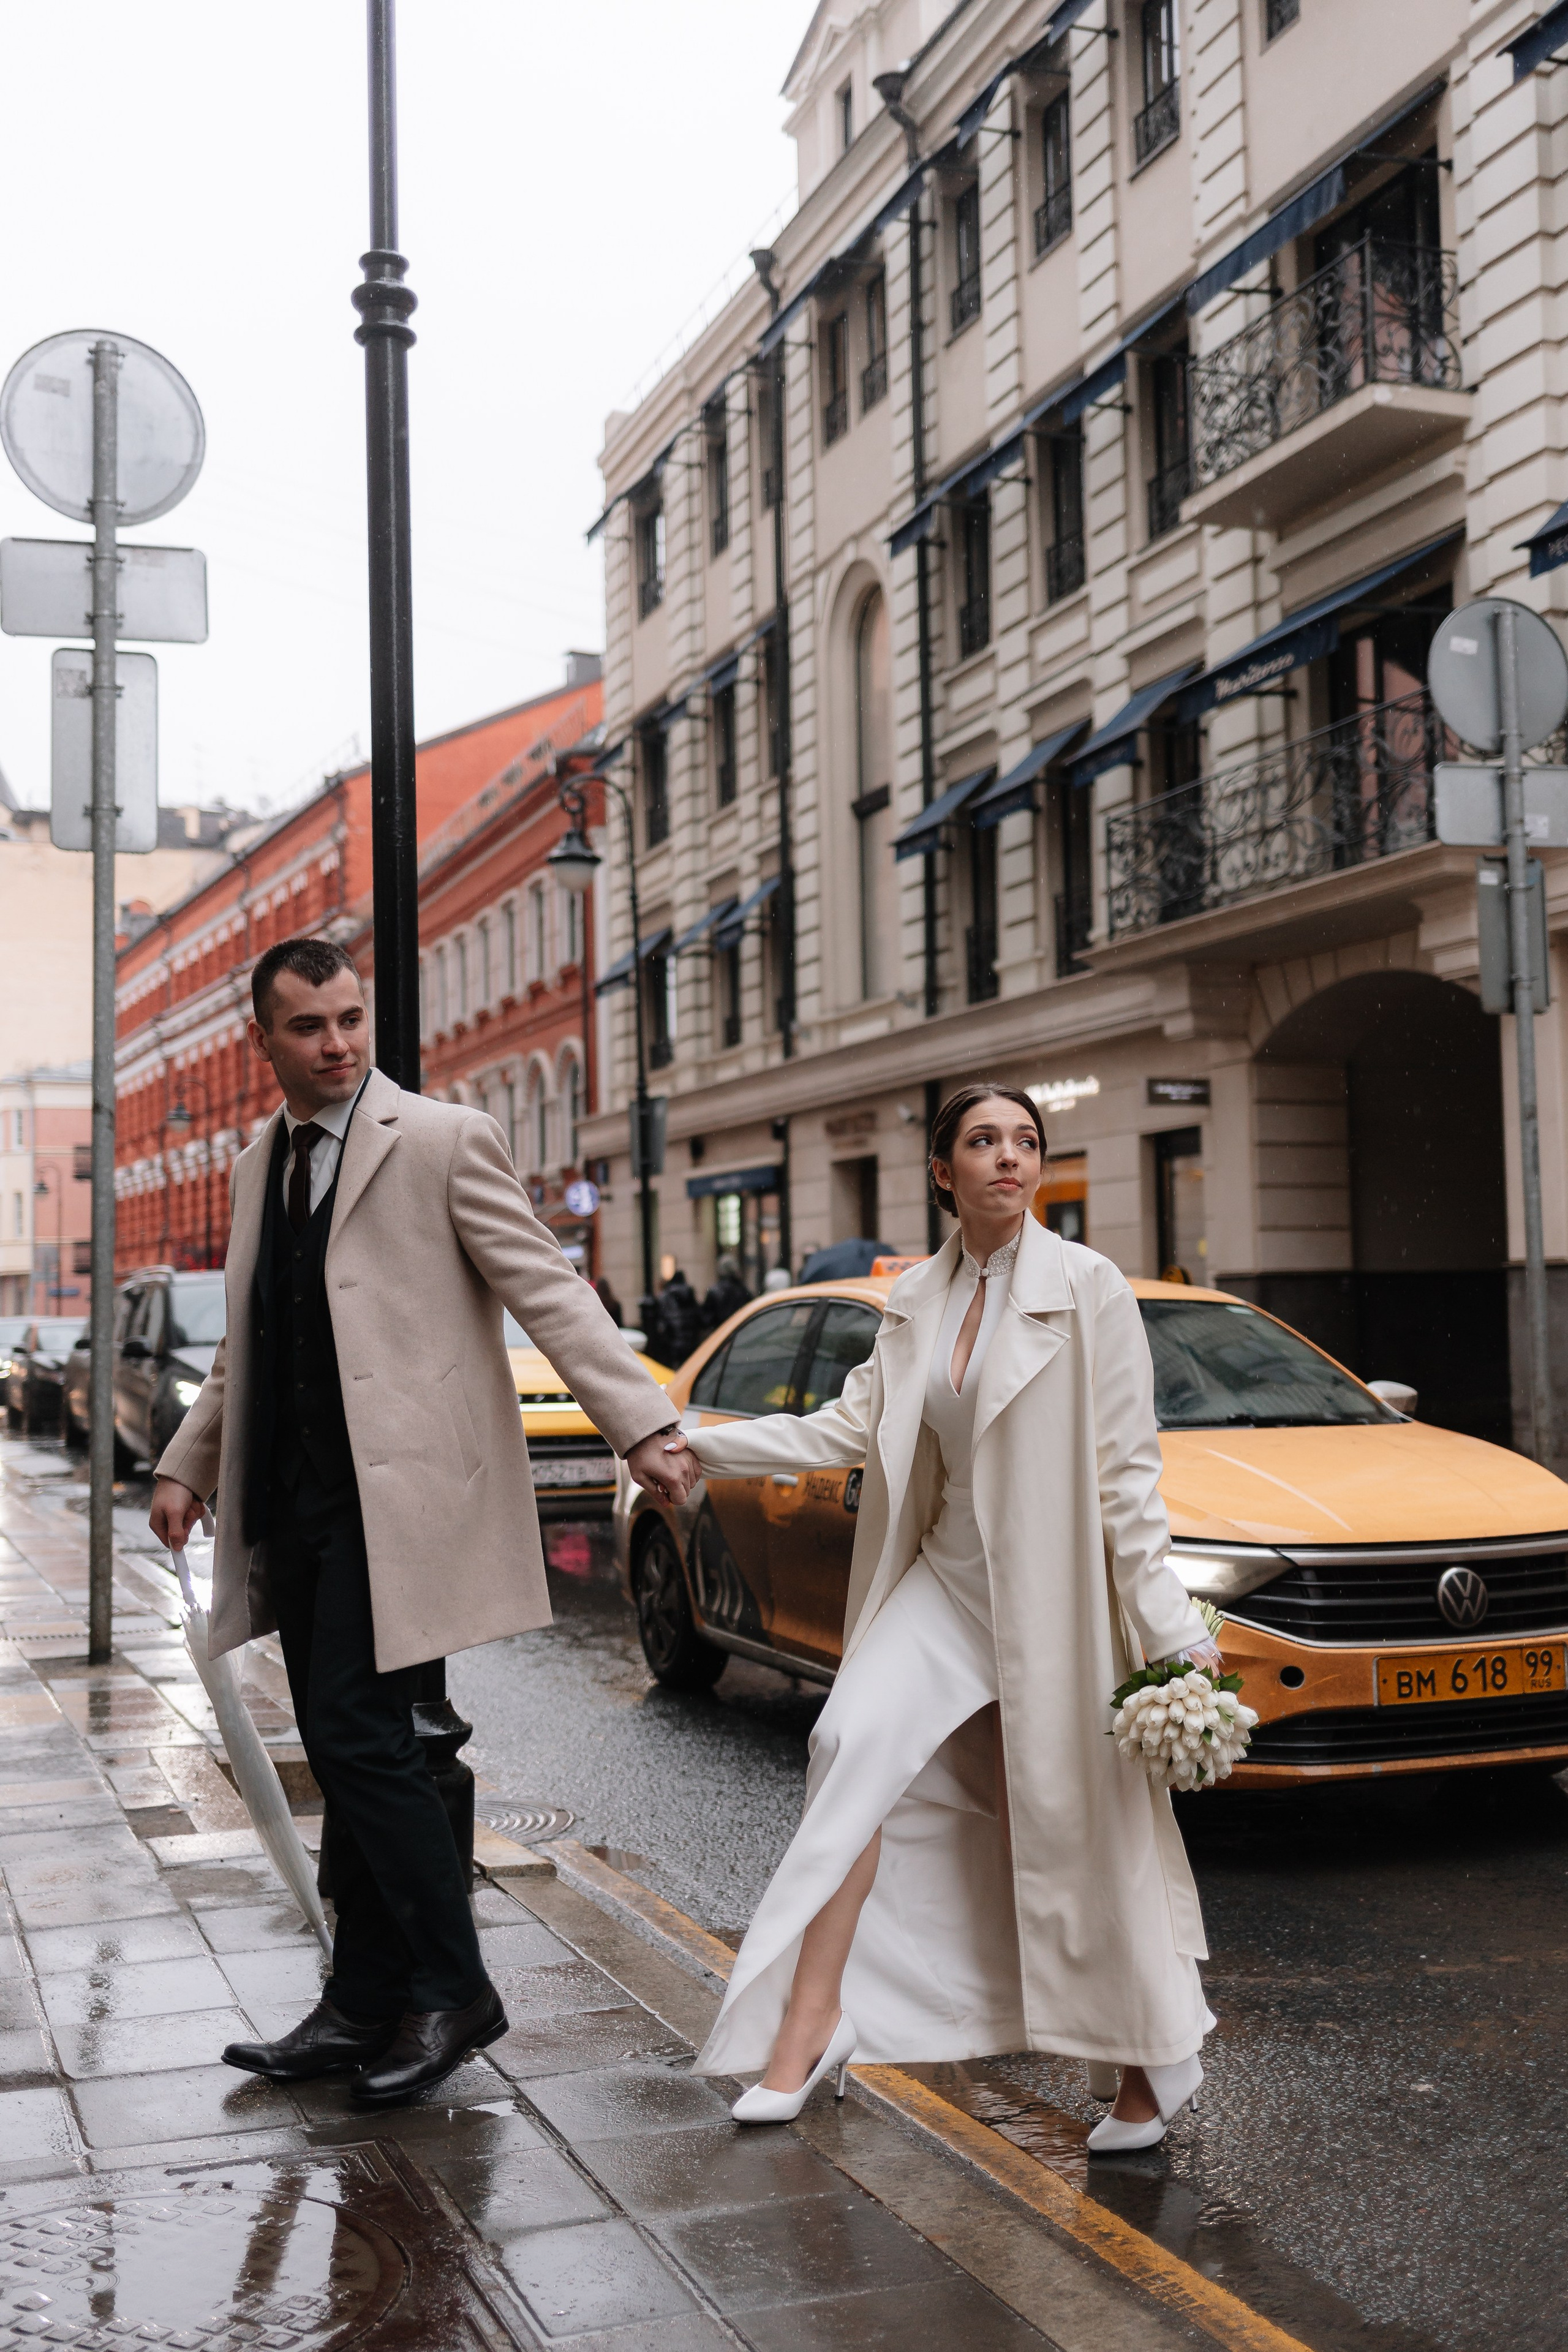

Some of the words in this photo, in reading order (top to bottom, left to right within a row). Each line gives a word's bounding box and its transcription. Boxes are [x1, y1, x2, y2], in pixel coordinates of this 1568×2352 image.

[1450, 1655, 1507, 1694] 618
[1525, 1649, 1553, 1677] 99
[1531, 1677, 1552, 1688] RUS
